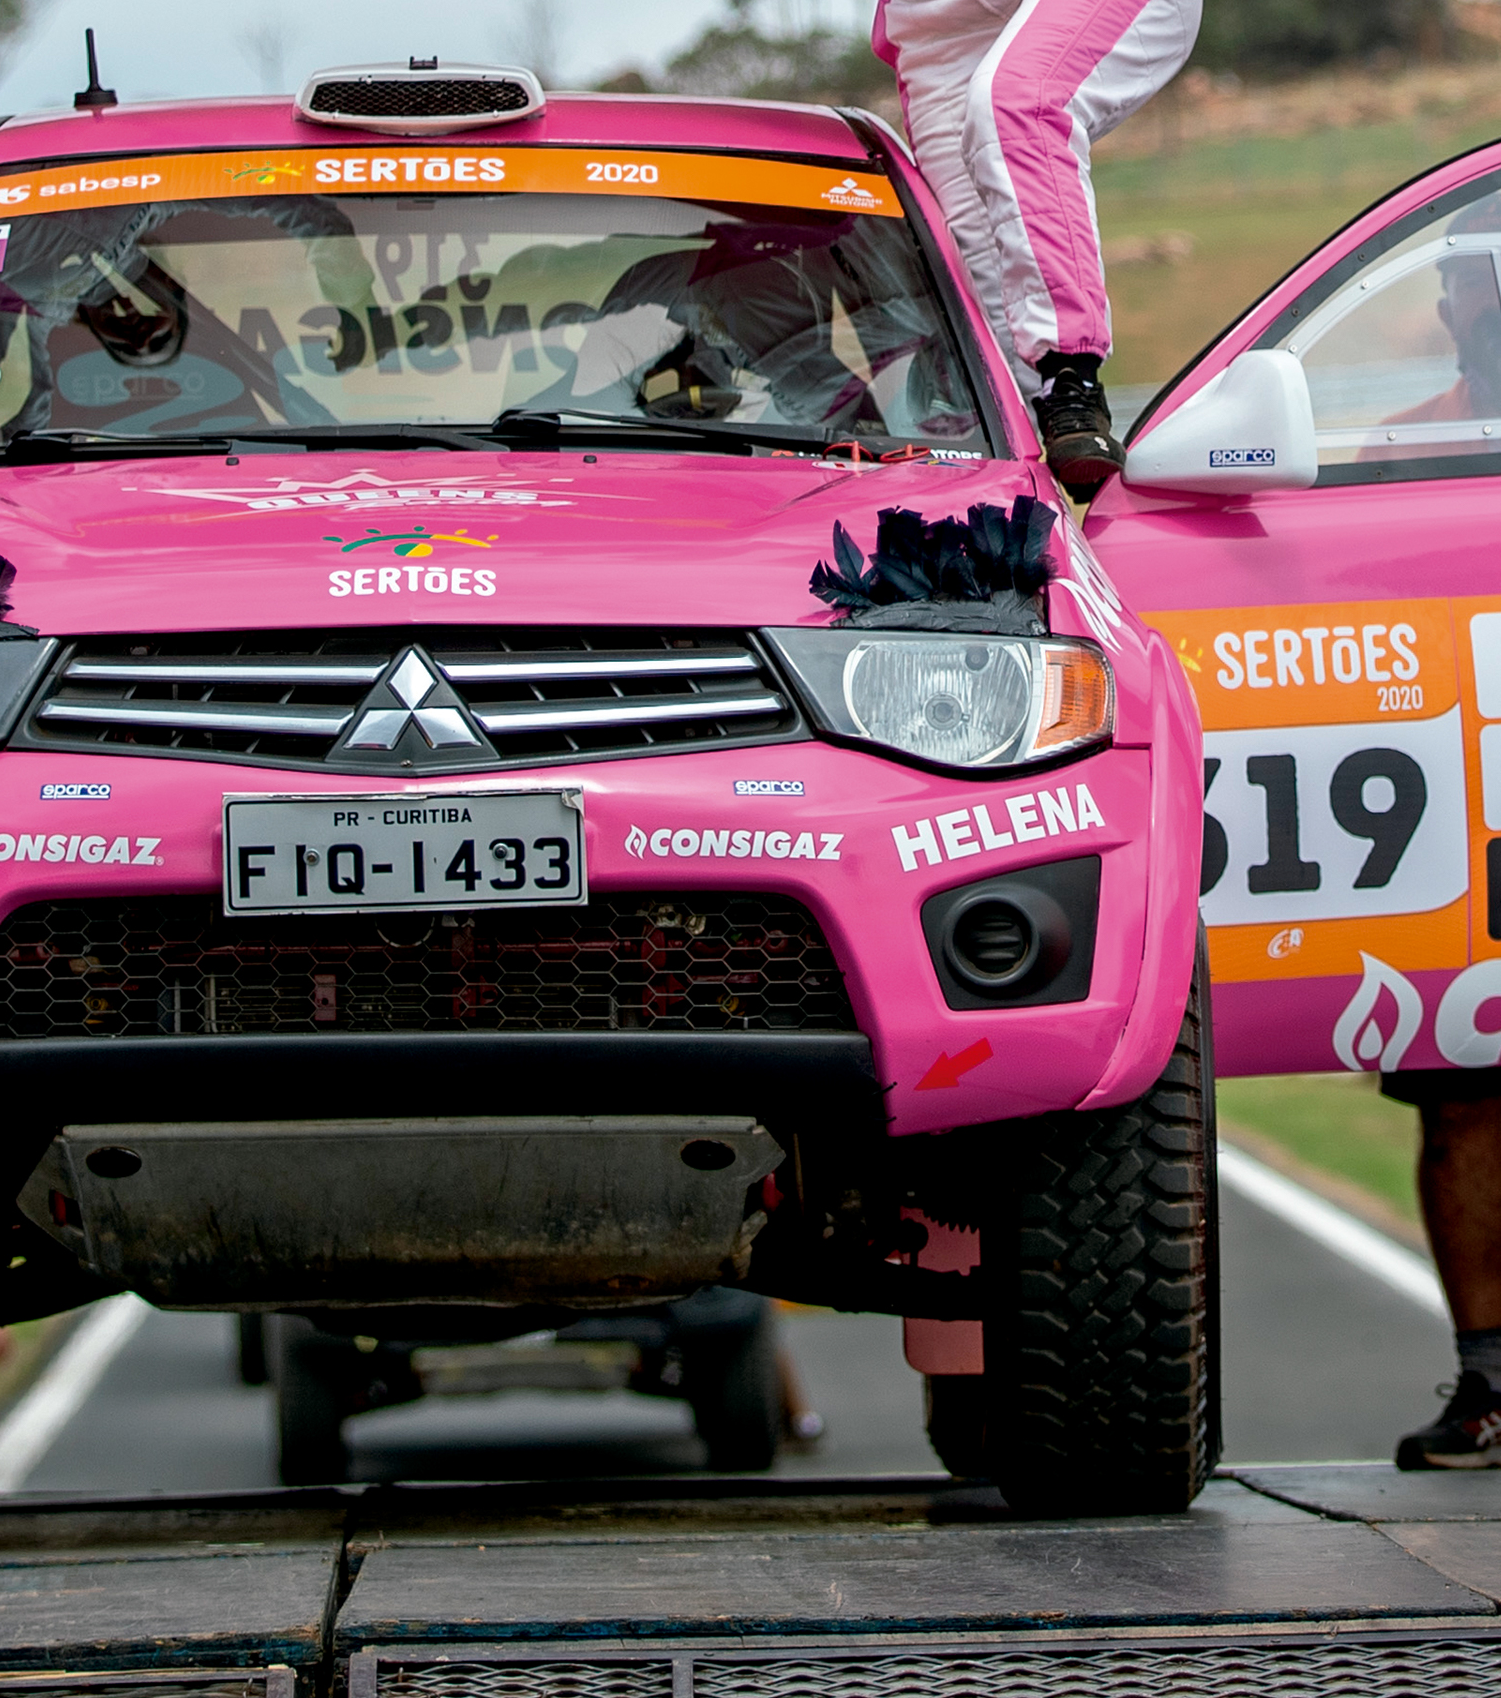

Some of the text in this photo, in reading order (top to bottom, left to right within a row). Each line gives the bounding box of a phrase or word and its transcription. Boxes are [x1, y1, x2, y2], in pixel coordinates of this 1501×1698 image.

[586, 161, 658, 184] 2020
[38, 173, 161, 198] sabesp
[1211, 449, 1275, 466] sparco
[247, 489, 539, 510] QUEENS
[1377, 685, 1424, 712] 2020
[42, 784, 111, 799] sparco
[735, 779, 804, 794] sparco
[334, 811, 359, 827] PR
[383, 807, 473, 825] CURITIBA
[891, 782, 1106, 873] HELENA
[650, 829, 844, 861] CONSIGAZ
[238, 836, 571, 899] FIQ-1433
